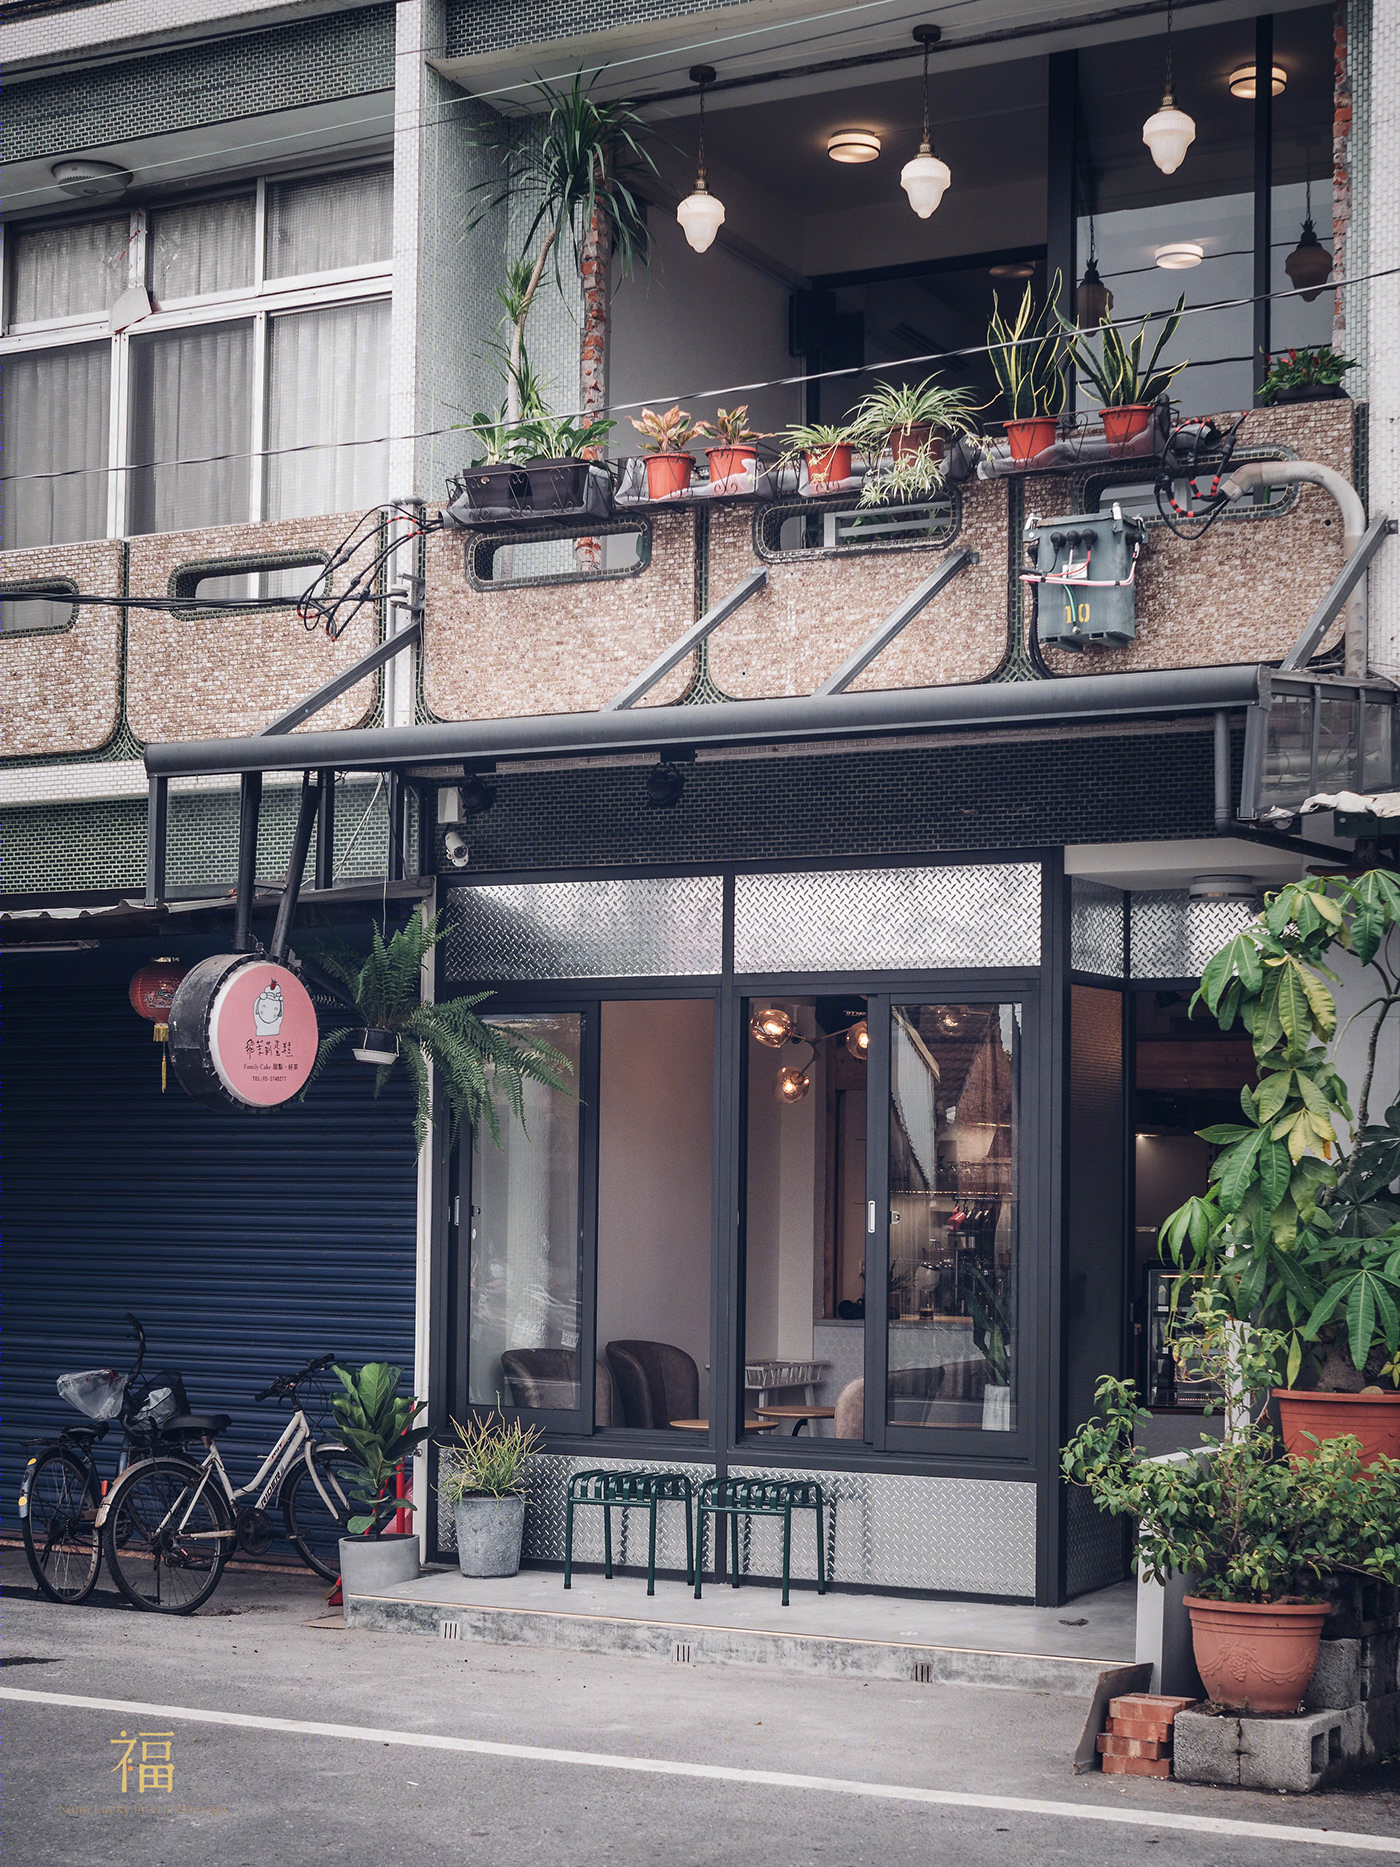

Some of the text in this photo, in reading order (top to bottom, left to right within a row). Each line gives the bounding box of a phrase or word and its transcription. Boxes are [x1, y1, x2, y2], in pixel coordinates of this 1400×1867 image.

[1064, 603, 1090, 624] 10
[244, 1063, 259, 1071] Family
[260, 1470, 281, 1509] RIDER
